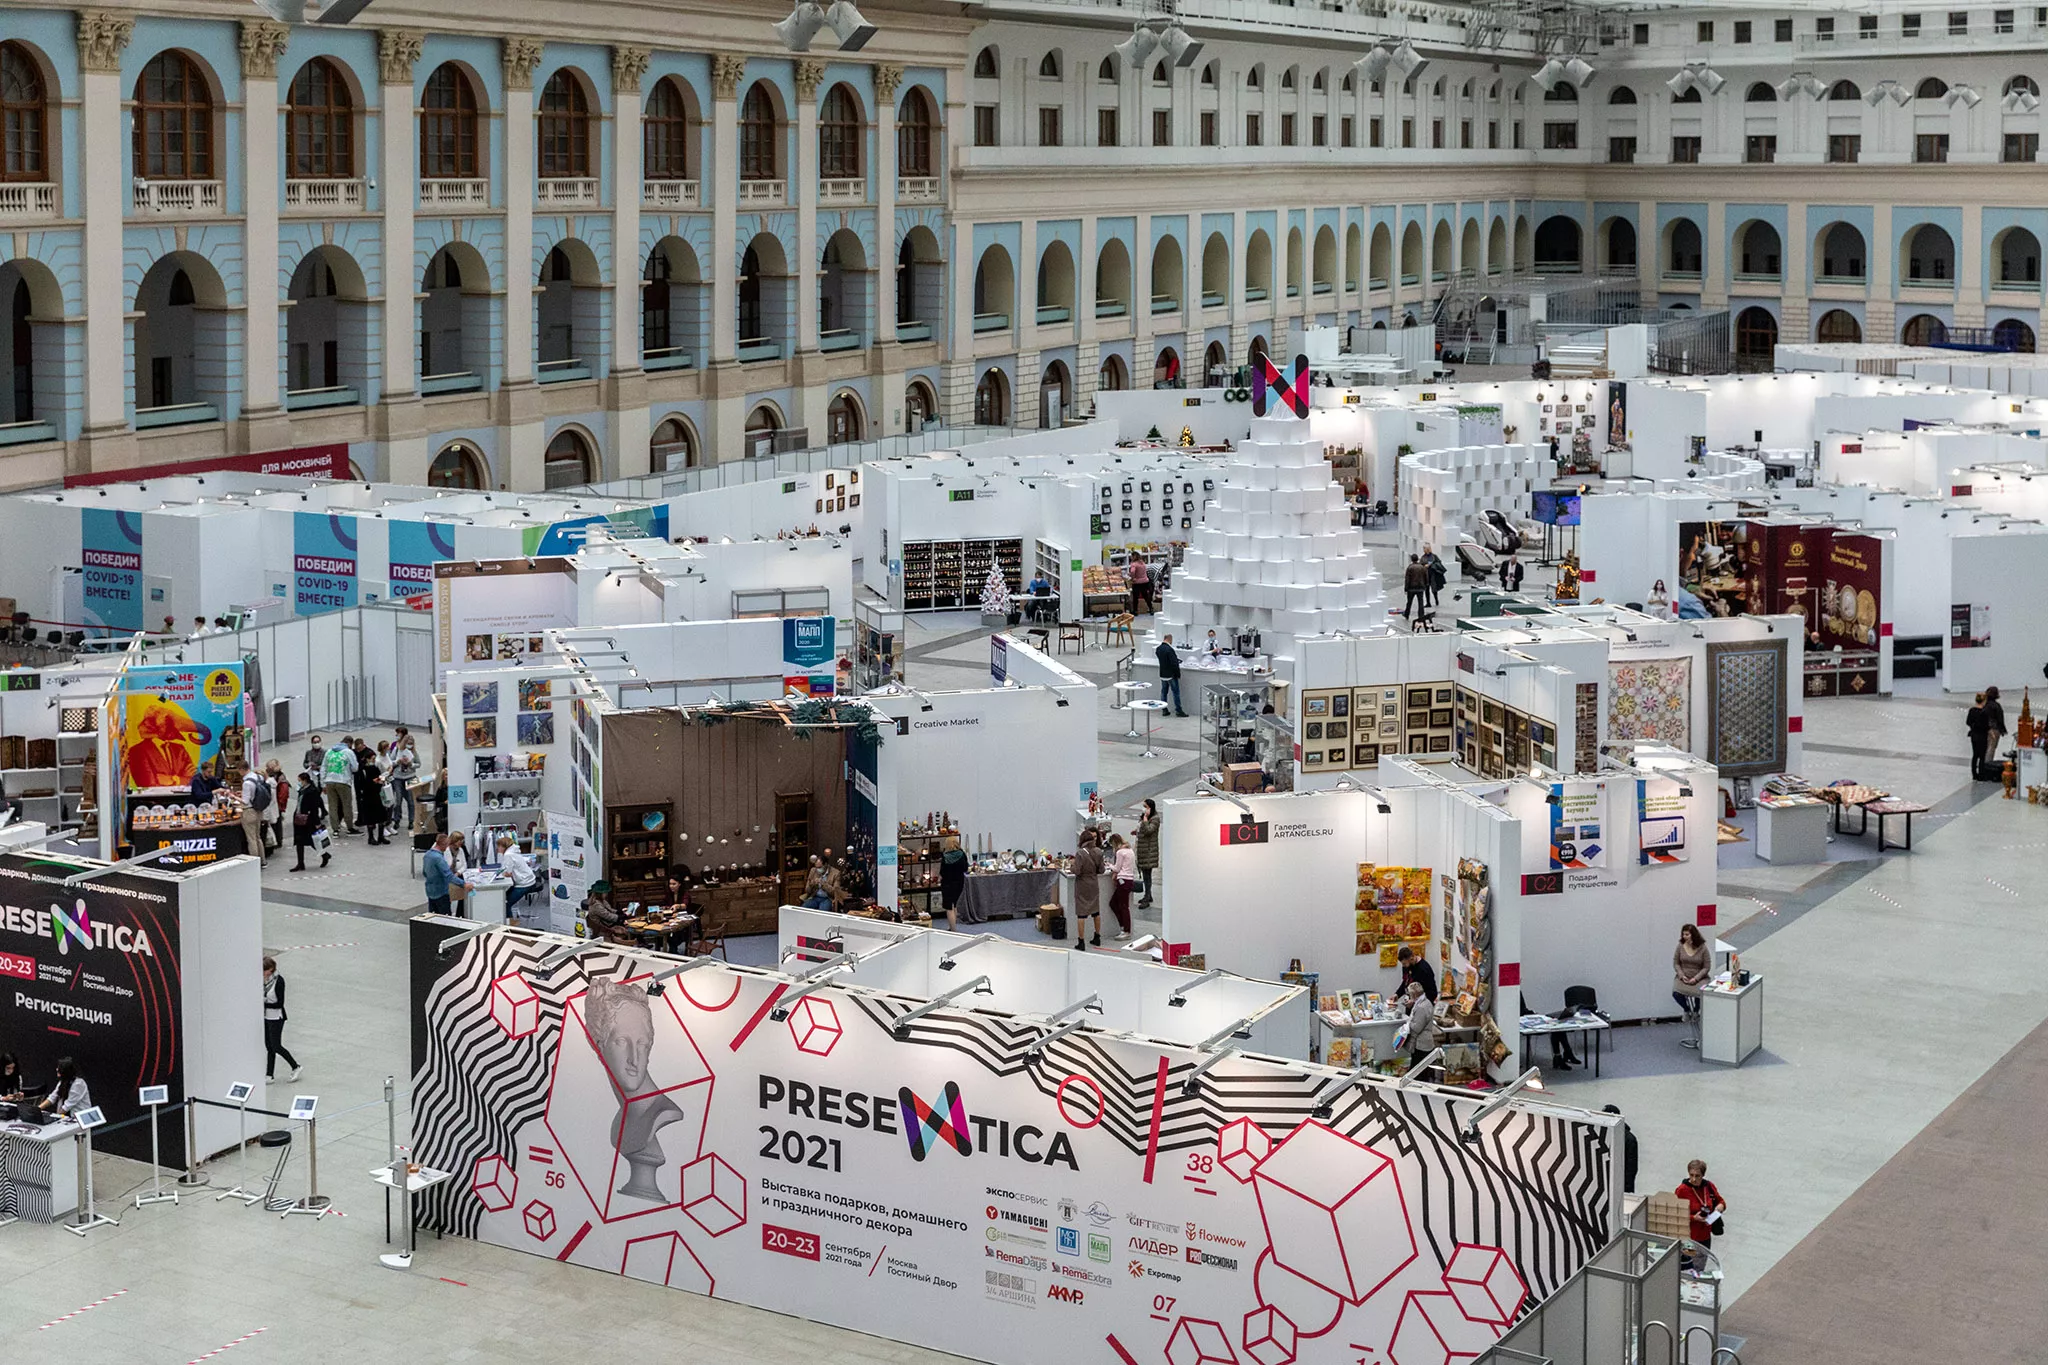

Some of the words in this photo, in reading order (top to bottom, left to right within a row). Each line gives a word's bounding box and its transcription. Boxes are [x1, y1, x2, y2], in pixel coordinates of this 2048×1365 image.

[261, 463, 280, 474] ДЛЯ
[282, 454, 332, 470] МОСКВИЧЕЙ
[85, 551, 139, 568] ПОБЕДИМ
[297, 557, 353, 574] ПОБЕДИМ
[86, 571, 134, 586] COVID-19
[297, 577, 348, 592] COVID-19
[86, 586, 131, 601] ВМЕСТЕ!
[297, 593, 344, 607] ВМЕСТЕ!
[442, 583, 450, 614] STORY
[442, 619, 450, 658] CANDLE
[798, 627, 820, 637] МАПП
[15, 676, 33, 688] A1
[178, 673, 198, 681] НЕ-
[914, 720, 948, 729] Creative
[950, 718, 979, 726] Market
[1237, 824, 1259, 841] C1
[1274, 823, 1307, 831] Галерея
[1274, 829, 1334, 838] ARTANGELS.RU
[173, 837, 217, 852] PUZZLE
[1534, 875, 1557, 891] C2
[1568, 874, 1598, 882] Подари
[1568, 881, 1618, 890] путешествие
[82, 881, 137, 899] праздничного
[138, 889, 167, 904] декора
[38, 963, 72, 977] сентября
[83, 972, 105, 983] Москва
[52, 975, 66, 984] года
[83, 980, 114, 994] Гостиный
[115, 985, 134, 997] Двор
[15, 992, 112, 1026] Регистрация
[759, 1074, 1080, 1171] PRESENTICA
[759, 1125, 842, 1173] 2021
[1187, 1153, 1213, 1174] 38
[545, 1170, 565, 1189] 56
[762, 1178, 821, 1201] Выставка
[825, 1192, 889, 1217] подарков,
[892, 1207, 968, 1232] домашнего
[762, 1196, 769, 1205] и
[773, 1198, 863, 1226] праздничного
[866, 1218, 913, 1238] декора
[1000, 1210, 1048, 1228] YAMAGUCHI
[1129, 1217, 1150, 1229] GIFT
[1152, 1221, 1180, 1234] REVIEW
[1199, 1228, 1247, 1248] flowwow
[825, 1241, 871, 1260] сентября
[826, 1253, 843, 1263] 2021
[844, 1257, 862, 1268] года
[887, 1256, 918, 1270] Москва
[996, 1250, 1048, 1271] RemaDays
[887, 1266, 931, 1284] Гостиный
[932, 1276, 957, 1290] Двор
[1062, 1265, 1112, 1286] RemaExtra
[1147, 1267, 1182, 1283] Expomap
[985, 1285, 997, 1296] 3/4
[999, 1287, 1036, 1305] АРШИНА
[1153, 1294, 1177, 1312] 07
